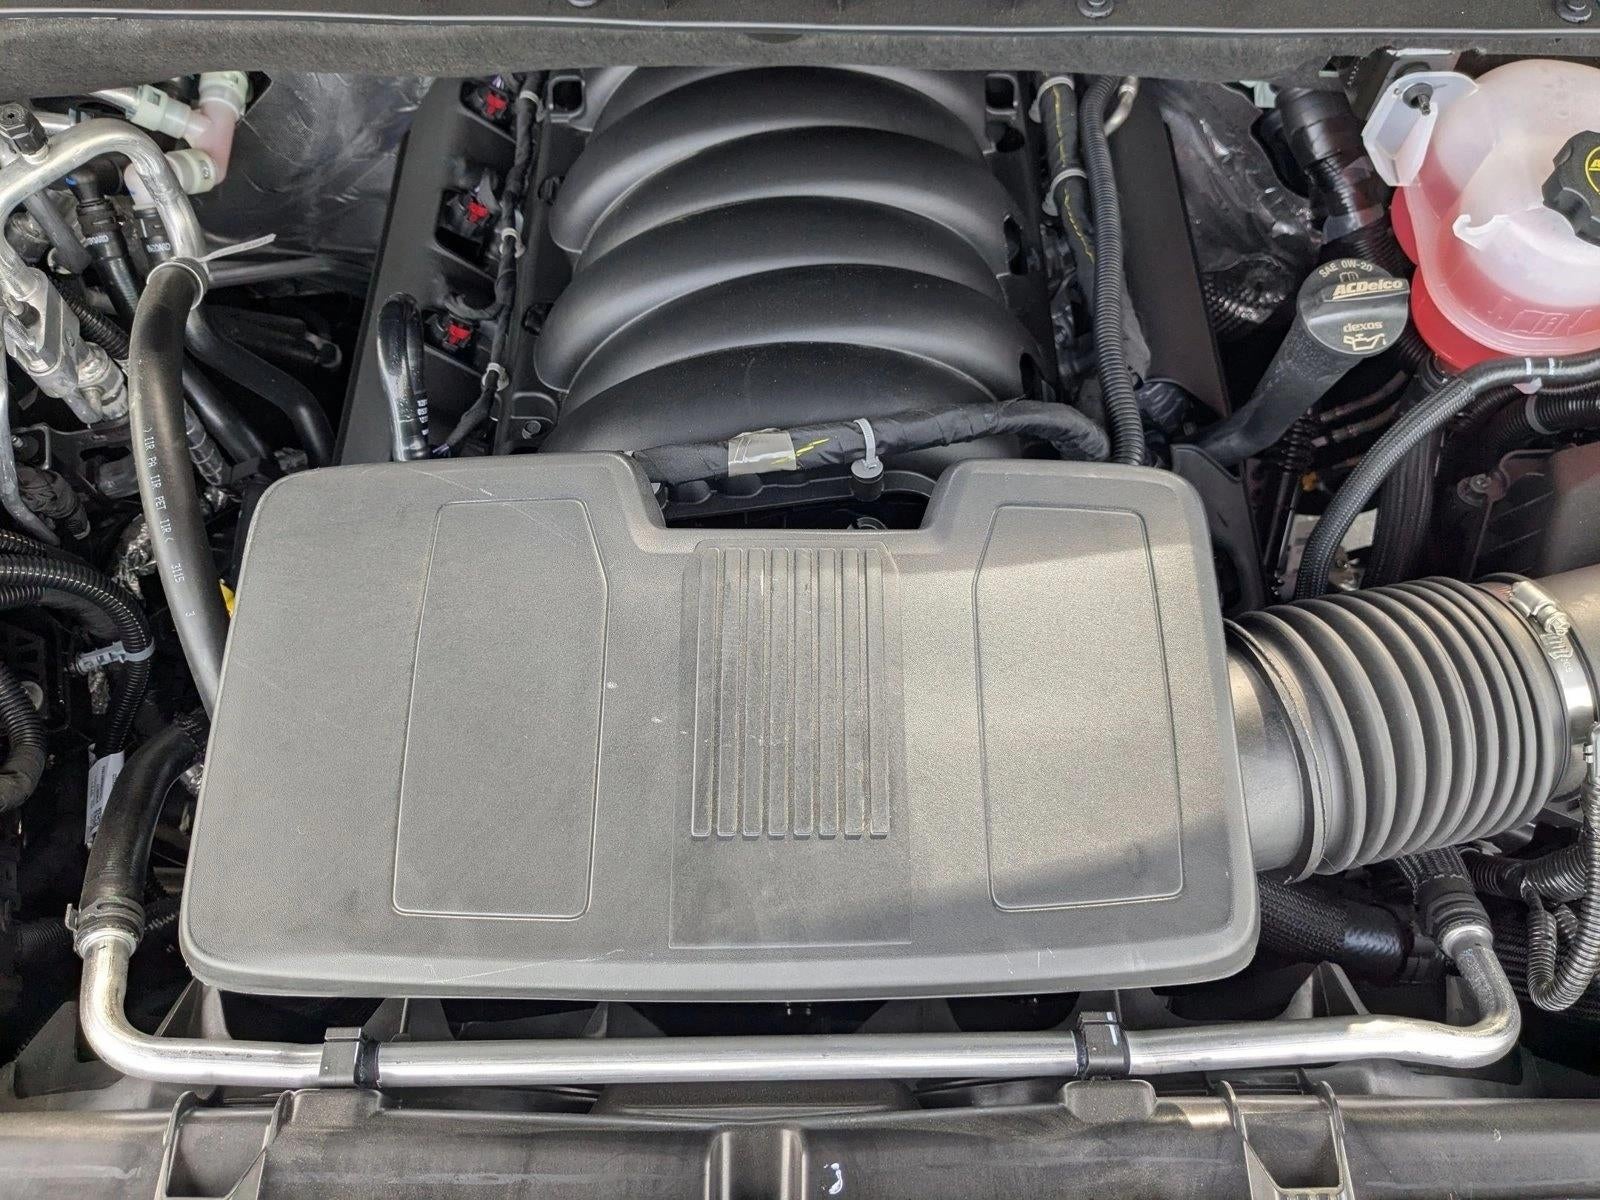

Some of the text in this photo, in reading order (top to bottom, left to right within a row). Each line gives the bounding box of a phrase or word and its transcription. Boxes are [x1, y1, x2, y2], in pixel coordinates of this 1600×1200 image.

[1318, 259, 1374, 278] SAE 0W-20
[1332, 279, 1403, 297] ACDelco
[1343, 321, 1384, 333] dexos
[154, 495, 167, 510] PET
